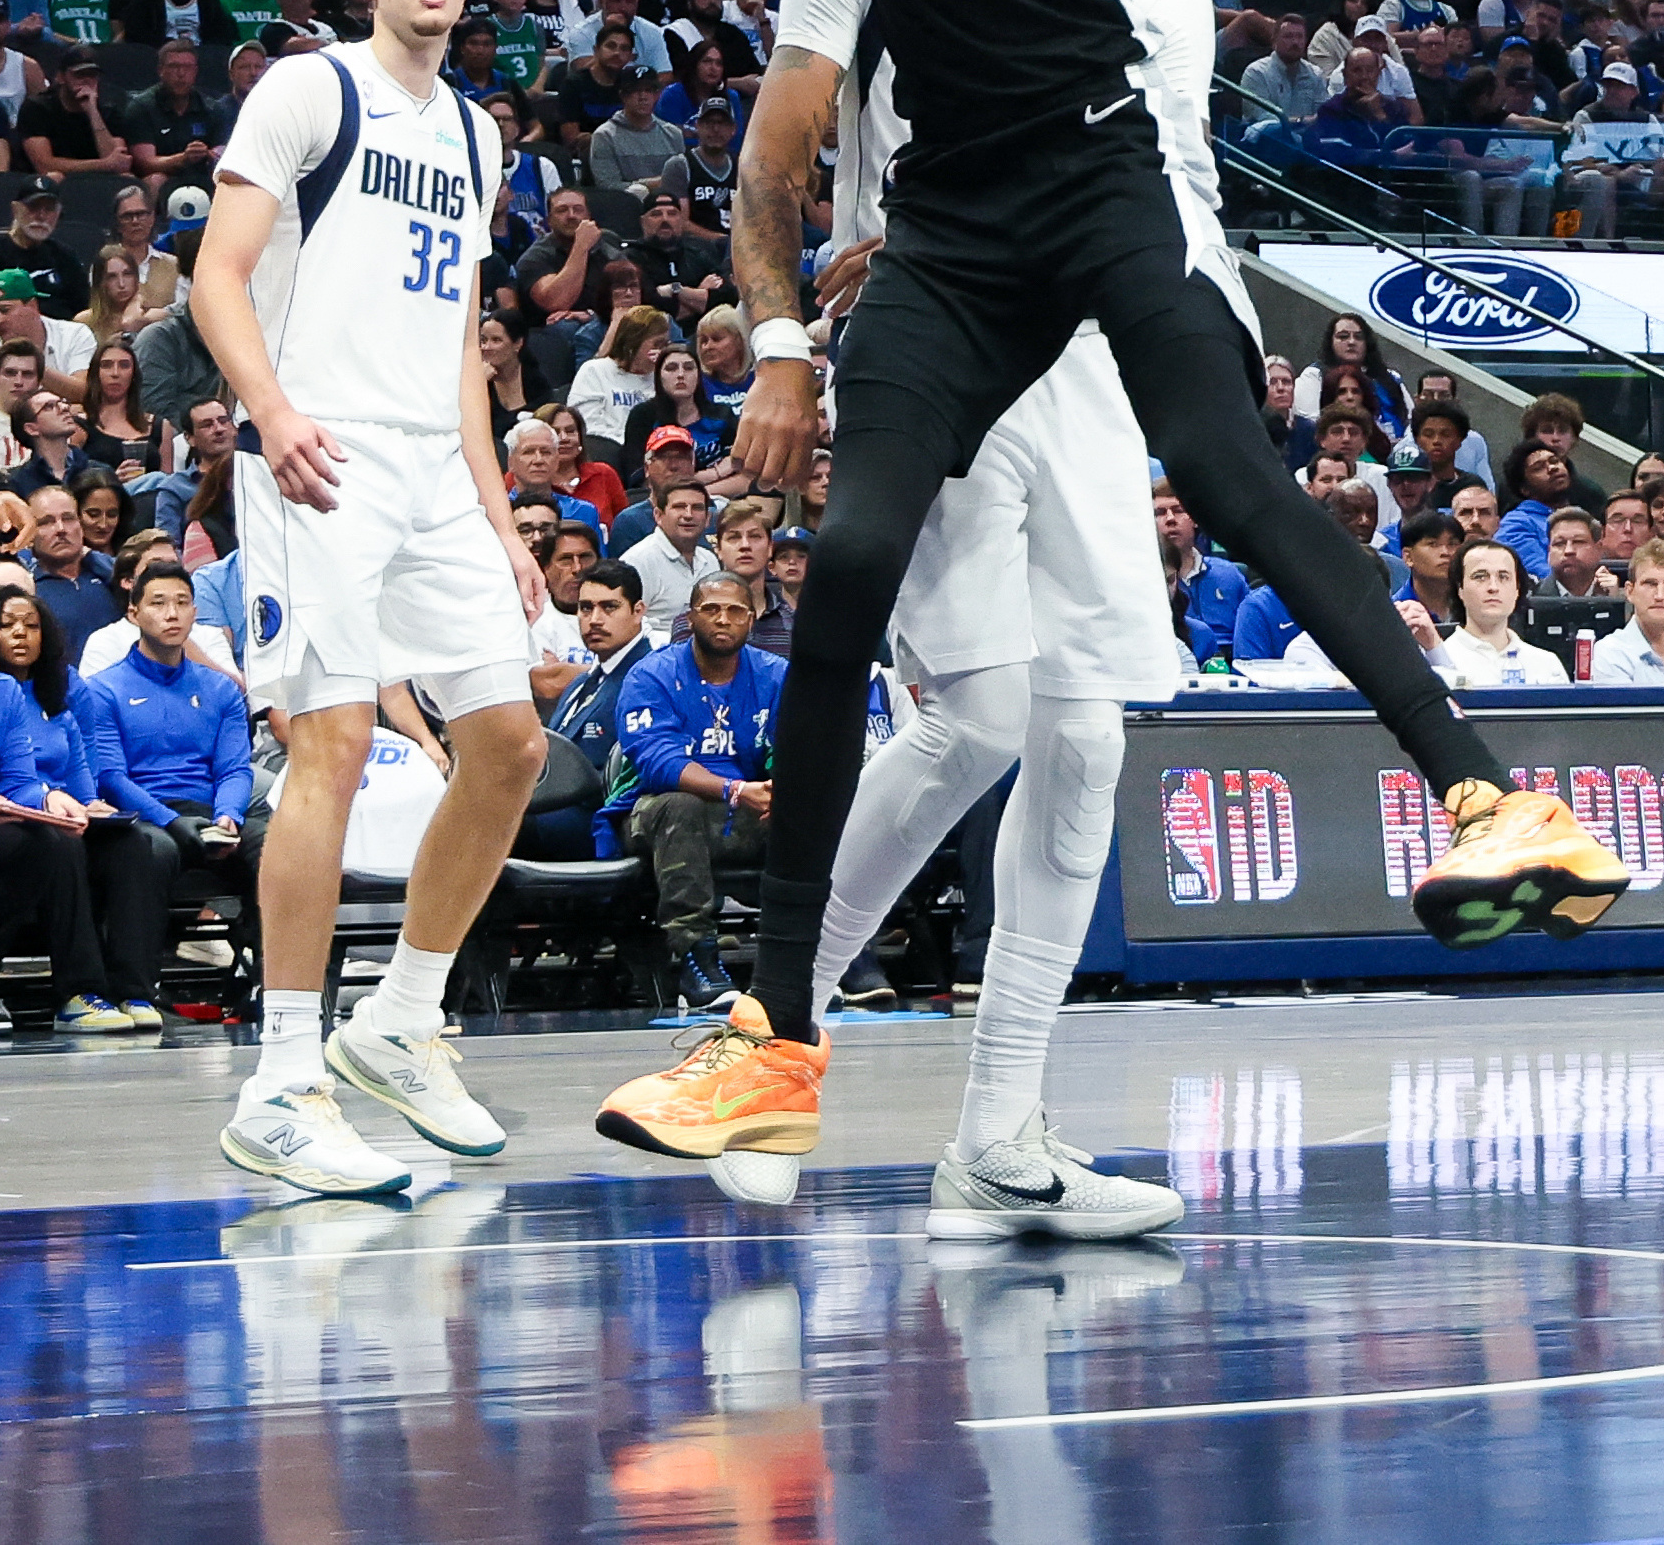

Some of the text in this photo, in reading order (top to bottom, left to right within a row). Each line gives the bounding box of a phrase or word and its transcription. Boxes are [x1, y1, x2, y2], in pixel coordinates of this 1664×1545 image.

[510, 56, 528, 78] 3
[359, 147, 466, 222] DALLAS
[403, 219, 462, 303] 32
[1411, 268, 1540, 330] Ford
[626, 708, 654, 733] 54
